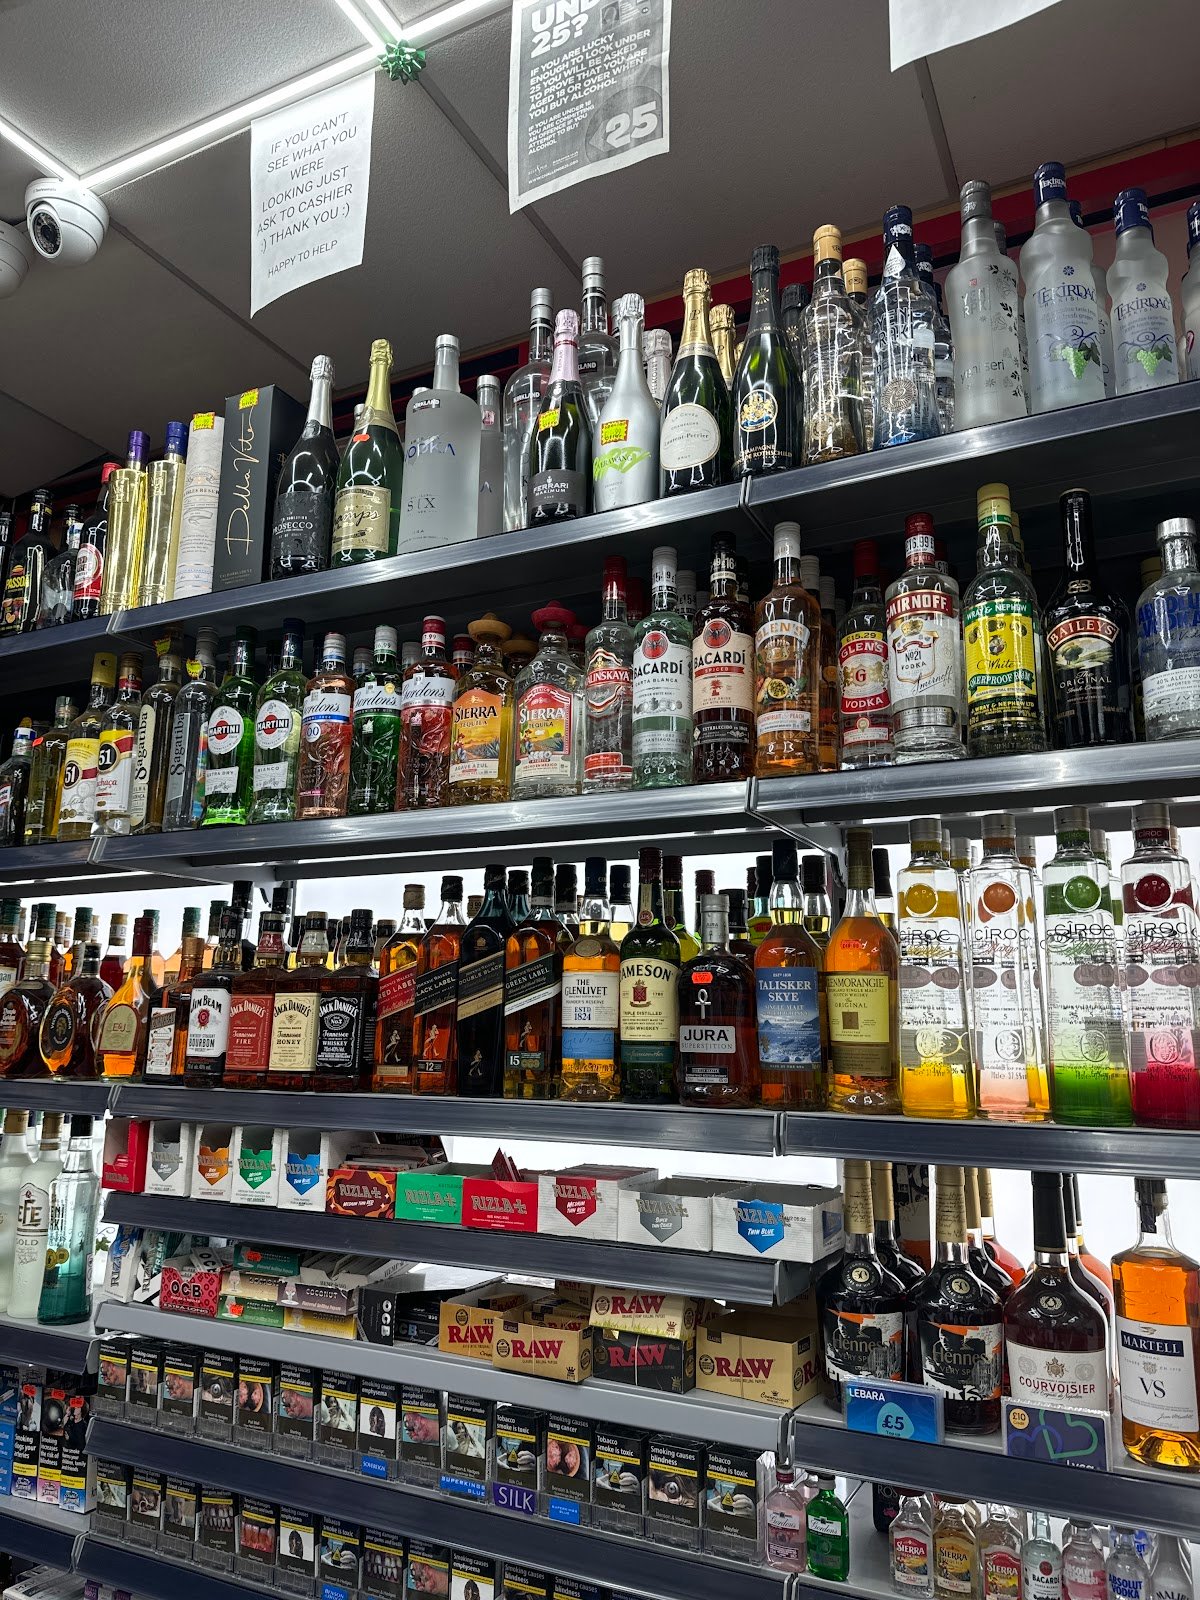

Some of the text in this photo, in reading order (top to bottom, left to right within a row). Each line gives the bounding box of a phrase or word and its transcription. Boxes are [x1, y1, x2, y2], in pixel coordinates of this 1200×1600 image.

[531, 13, 588, 58] 25?
[530, 33, 614, 77] IF YOU ARE LUCKY
[530, 29, 650, 85] ENOUGH TO LOOK UNDER
[529, 44, 638, 95] 25 YOU WILL BE ASKED
[530, 48, 648, 102] TO PROVE THAT YOU ARE
[529, 57, 644, 112] AGED 18 OR OVER WHEN
[529, 78, 617, 120] YOU BUY ALCOHOL
[605, 100, 658, 148] 25
[270, 112, 348, 154] IF YOU CAN'T
[267, 126, 356, 173] SEE WHAT YOU
[528, 139, 557, 155] ALCOHOL
[290, 158, 324, 180] WERE
[262, 166, 348, 212] LOOKING JUST
[257, 184, 352, 236] ASK TO CASHIER
[270, 207, 338, 246] THANK YOU
[268, 240, 337, 278] HAPPY TO HELP
[533, 481, 569, 492] FERRARI
[886, 594, 947, 623] SMIRNOFF
[1050, 620, 1113, 642] BAILEYS
[841, 642, 884, 658] GLEN'S
[694, 650, 746, 669] BACARDÍ
[901, 661, 927, 670] VODKA
[1059, 677, 1112, 689] ORIGINAL
[845, 698, 884, 709] VODKA
[454, 706, 498, 723] SIERRA
[519, 707, 566, 724] SIERRA
[209, 724, 240, 738] MARTINI
[257, 719, 289, 731] MARTINI
[135, 712, 148, 780] Sagatiba
[170, 713, 185, 776] Sagatiba
[99, 750, 111, 765] 51
[65, 765, 76, 782] 51
[435, 977, 456, 989] LABEL
[458, 963, 503, 986] DOUBLE BLACK
[505, 967, 550, 989] GREEN LABEL
[393, 979, 416, 994] LABEL
[565, 986, 607, 996] GLENLIVET
[759, 980, 811, 990] TALISKER
[191, 995, 222, 1013] JIM BEAM
[768, 993, 799, 1002] SKYE
[230, 1000, 265, 1017] JACK DANIEL'S
[274, 1000, 311, 1017] JACK DANIEL'S
[319, 999, 359, 1017] JACK DANIEL'S
[574, 1013, 591, 1021] 1824
[189, 1038, 215, 1048] BOURBON
[683, 1029, 728, 1041] JURA
[426, 1062, 434, 1071] 12
[510, 1055, 520, 1065] 15
[171, 1280, 201, 1298] OCB
[305, 1288, 337, 1299] COCONUT
[611, 1295, 666, 1315] RAW
[380, 1299, 391, 1337] OCB
[448, 1325, 493, 1344] RAW
[511, 1339, 563, 1359] RAW
[1123, 1335, 1180, 1354] MARTELL
[608, 1343, 666, 1367] RAW
[714, 1357, 774, 1379] RAW
[1019, 1376, 1095, 1394] COURVOISIER
[1139, 1377, 1166, 1398] VS
[849, 1388, 885, 1401] LEBARA
[497, 1414, 515, 1424] Tobacco
[882, 1415, 904, 1431] £5
[1012, 1412, 1026, 1422] £10
[597, 1436, 618, 1446] Tobacco
[597, 1445, 614, 1454] smoke
[621, 1447, 633, 1457] toxic
[650, 1446, 696, 1461] Smoking causes
[650, 1454, 678, 1466] blindness
[708, 1454, 731, 1466] Tobacco
[708, 1463, 748, 1477] smoke toxic
[498, 1486, 533, 1512] SILK
[896, 1541, 925, 1555] SIERRA
[939, 1547, 968, 1560] SIERRA
[986, 1563, 1018, 1575] SIERRA
[1108, 1574, 1143, 1590] ABSOLUT
